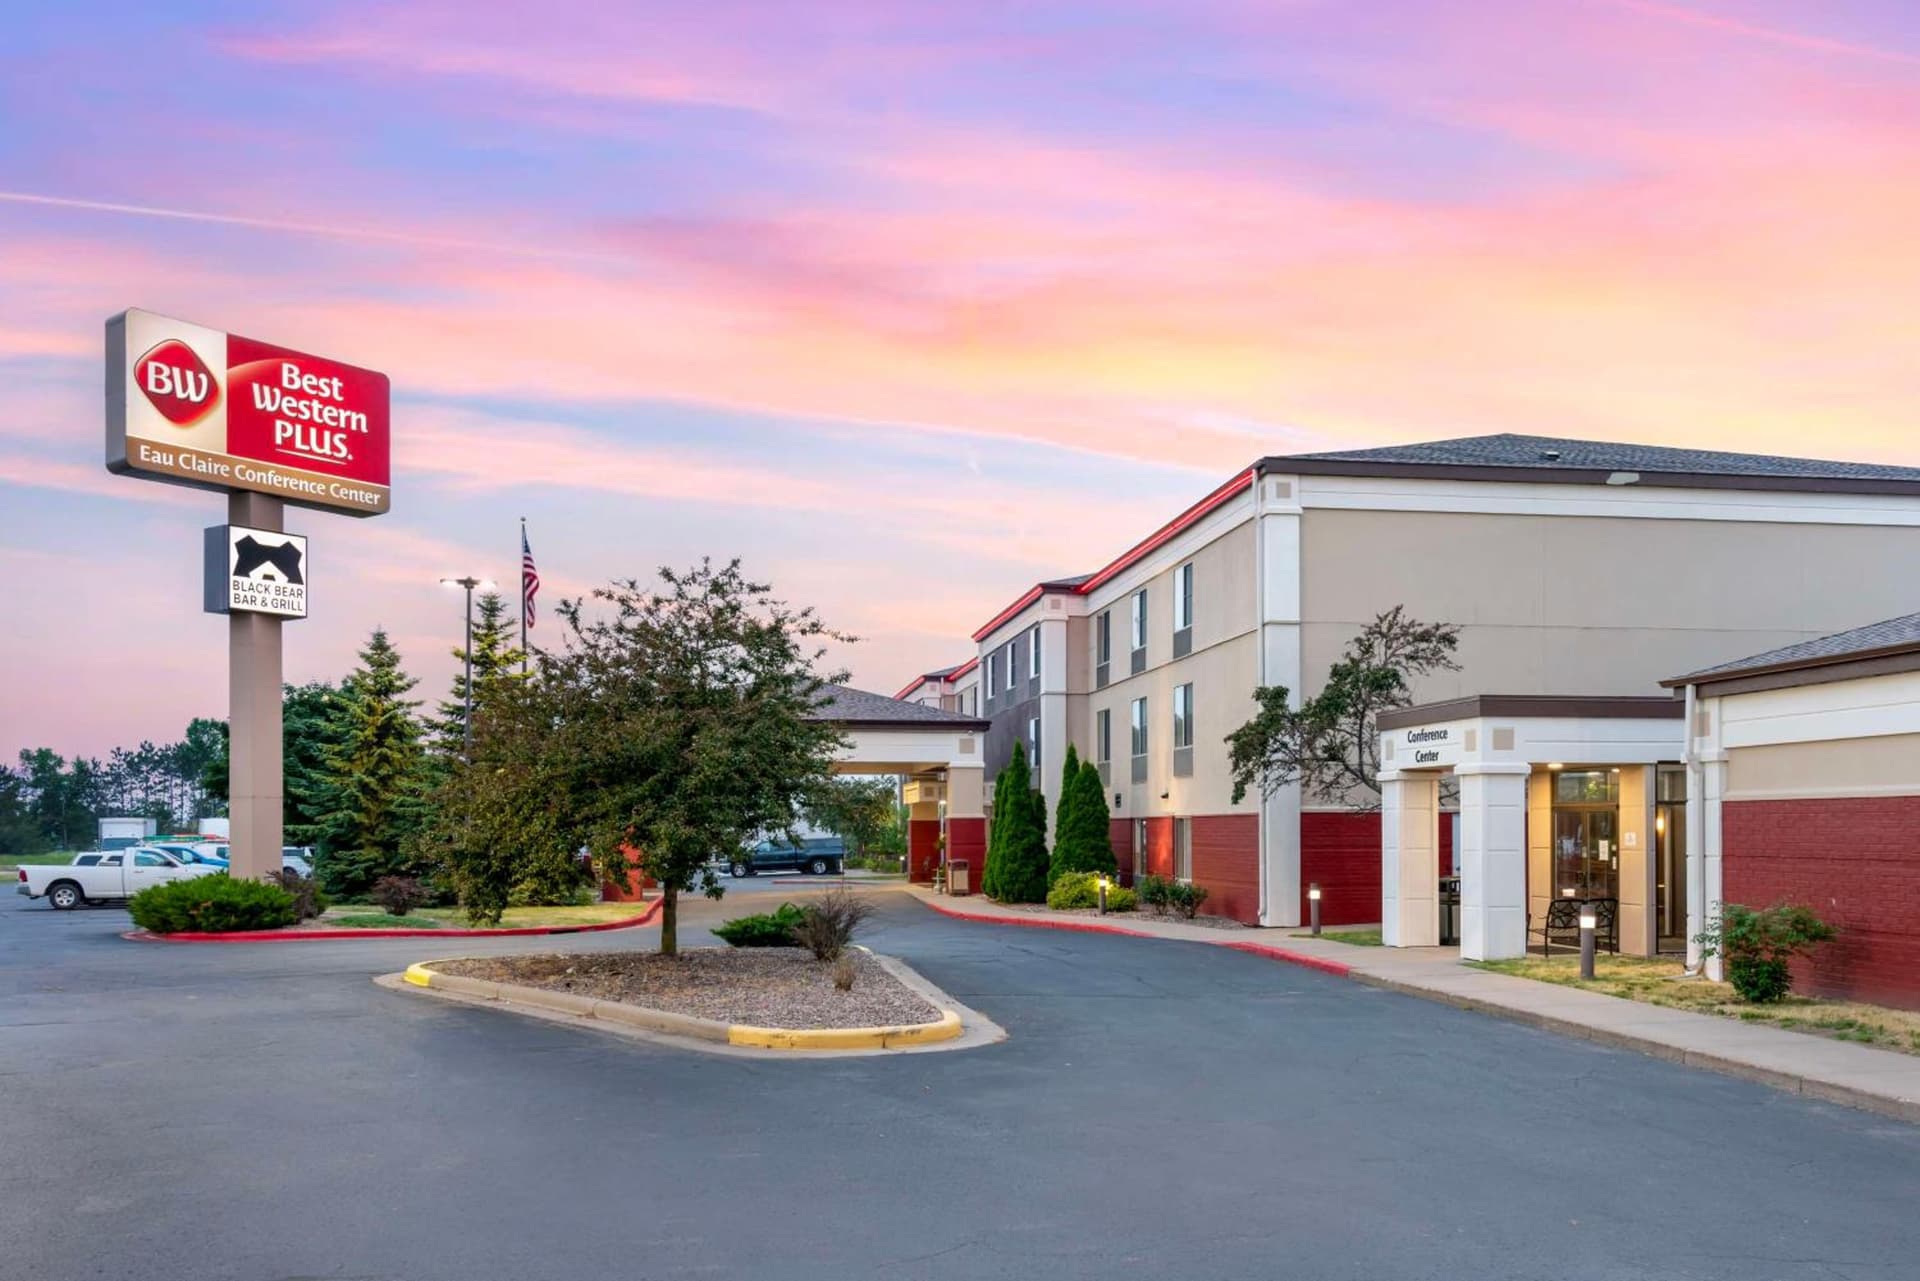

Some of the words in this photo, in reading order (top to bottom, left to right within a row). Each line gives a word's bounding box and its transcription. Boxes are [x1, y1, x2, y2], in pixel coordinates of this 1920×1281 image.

[147, 361, 208, 403] BW
[282, 363, 344, 401] Best
[252, 383, 368, 433] Western
[140, 444, 174, 467] Eau
[179, 452, 230, 477] Claire
[235, 465, 326, 495] Conference
[330, 483, 381, 506] Center
[233, 580, 271, 595] BLACK
[275, 585, 303, 599] BEAR
[234, 593, 257, 606] BAR
[260, 597, 268, 608] &
[271, 598, 303, 611] GRILL
[1408, 728, 1448, 743] Conference
[1415, 751, 1439, 763] Center
